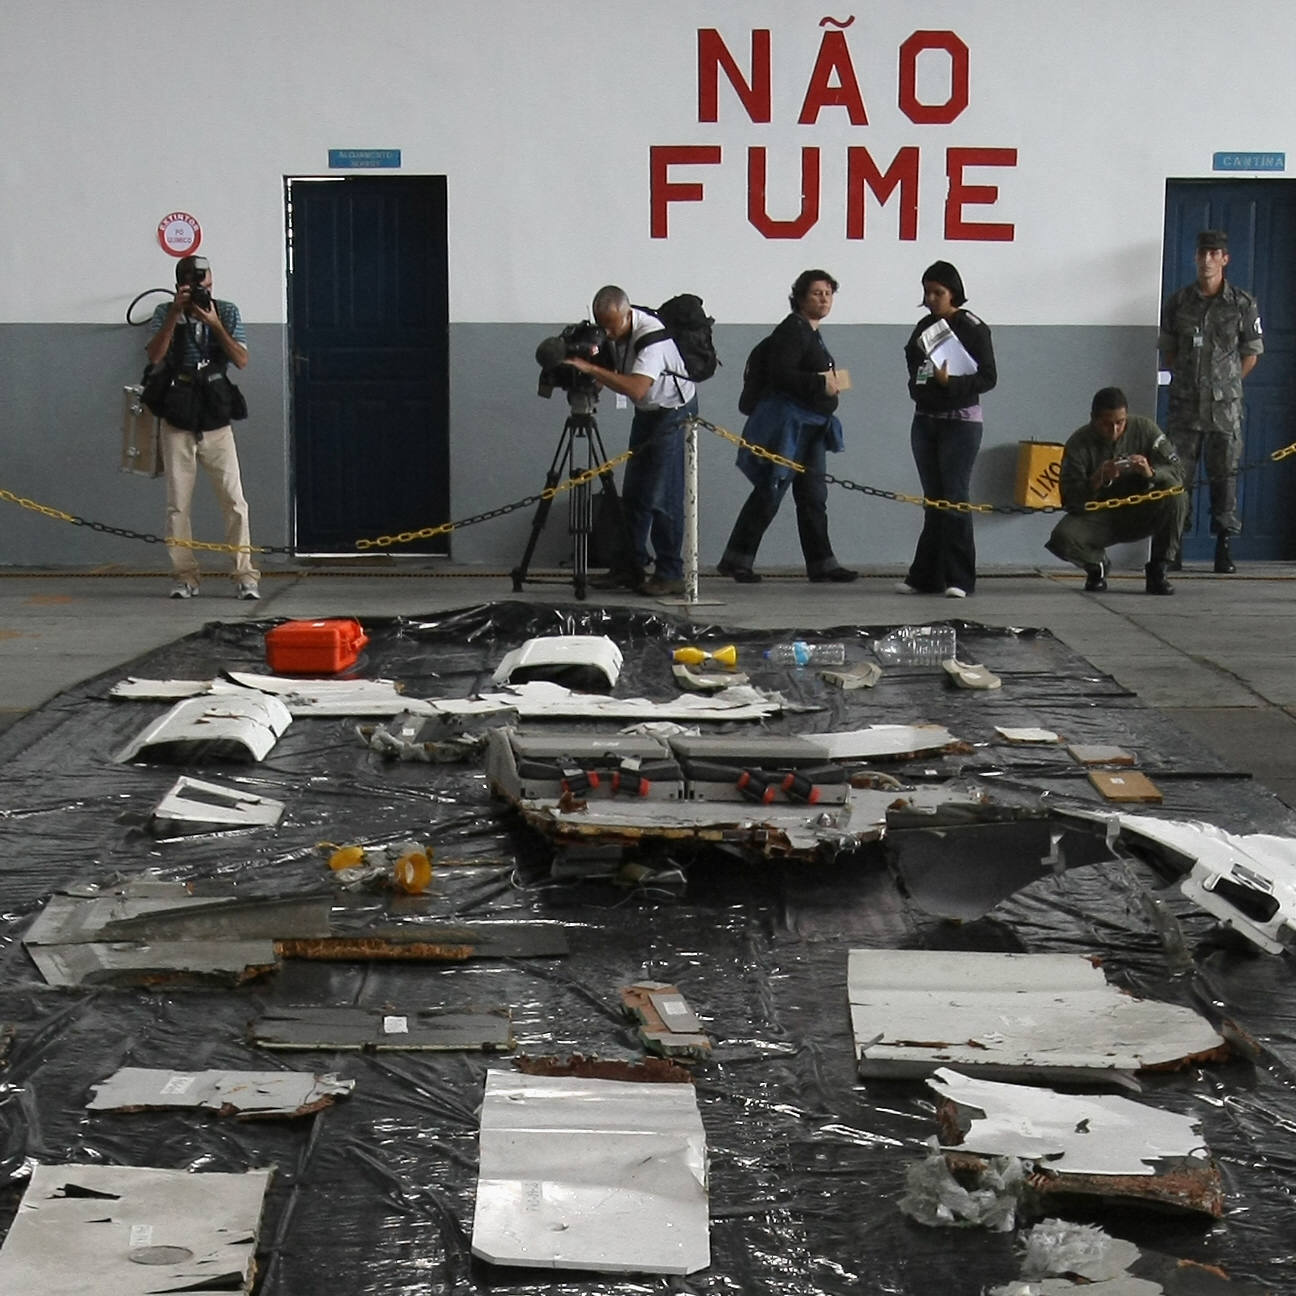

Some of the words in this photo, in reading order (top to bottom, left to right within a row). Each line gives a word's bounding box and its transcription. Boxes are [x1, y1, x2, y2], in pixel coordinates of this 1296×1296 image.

[697, 15, 969, 126] NÃO
[1223, 155, 1284, 167] CANTINA
[649, 145, 1018, 241] FUME
[158, 212, 200, 232] EXTINTOR
[1029, 461, 1063, 500] LIXO
